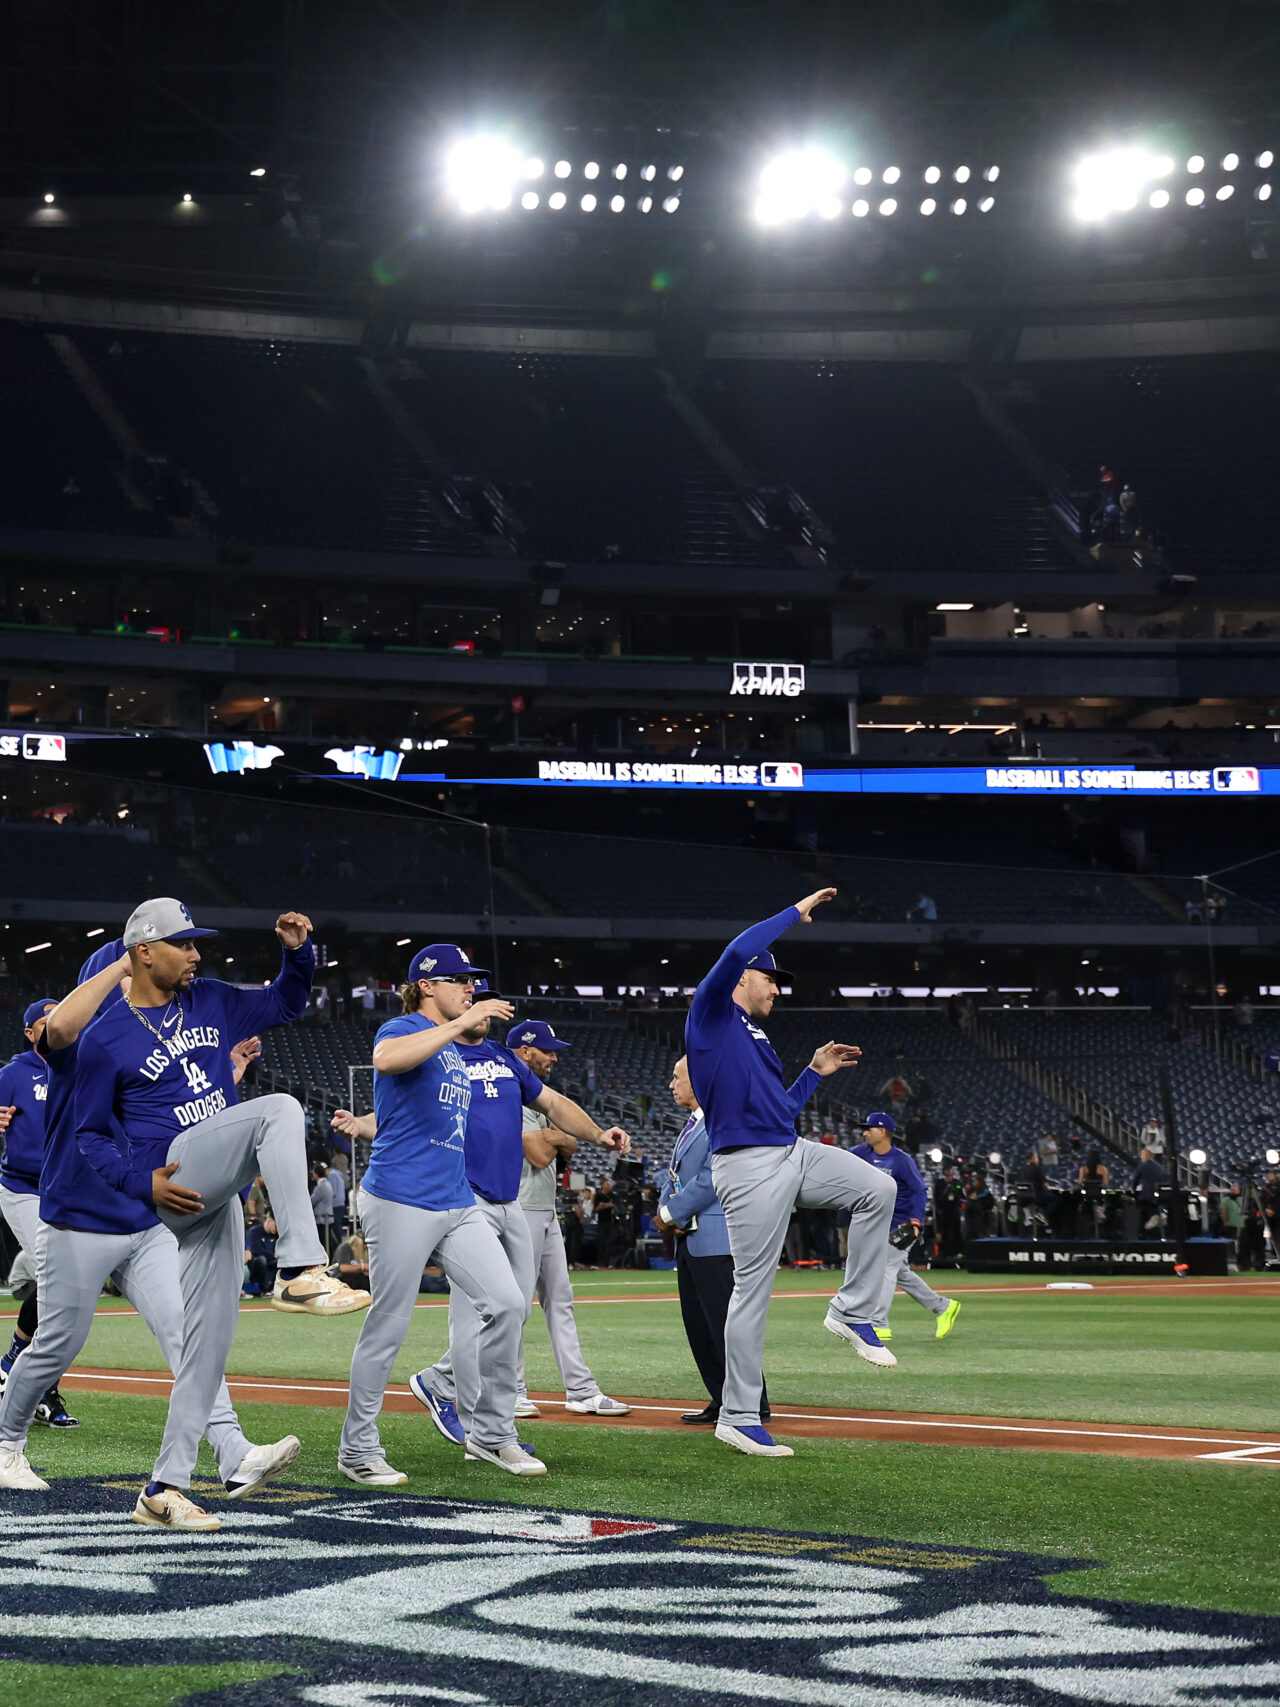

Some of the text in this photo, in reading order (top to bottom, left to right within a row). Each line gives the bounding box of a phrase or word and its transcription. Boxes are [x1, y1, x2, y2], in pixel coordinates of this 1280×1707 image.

[730, 675, 801, 696] KPMG
[539, 761, 758, 784] BASEBALL IS SOMETHING ELSE
[986, 769, 1211, 790] BASEBALL IS SOMETHING ELSE
[139, 1027, 220, 1082] LOS ANGELES
[179, 1056, 212, 1094] LA
[438, 1082, 472, 1111] OPTIO
[482, 1080, 498, 1098] LA
[173, 1087, 227, 1127] DODGERS
